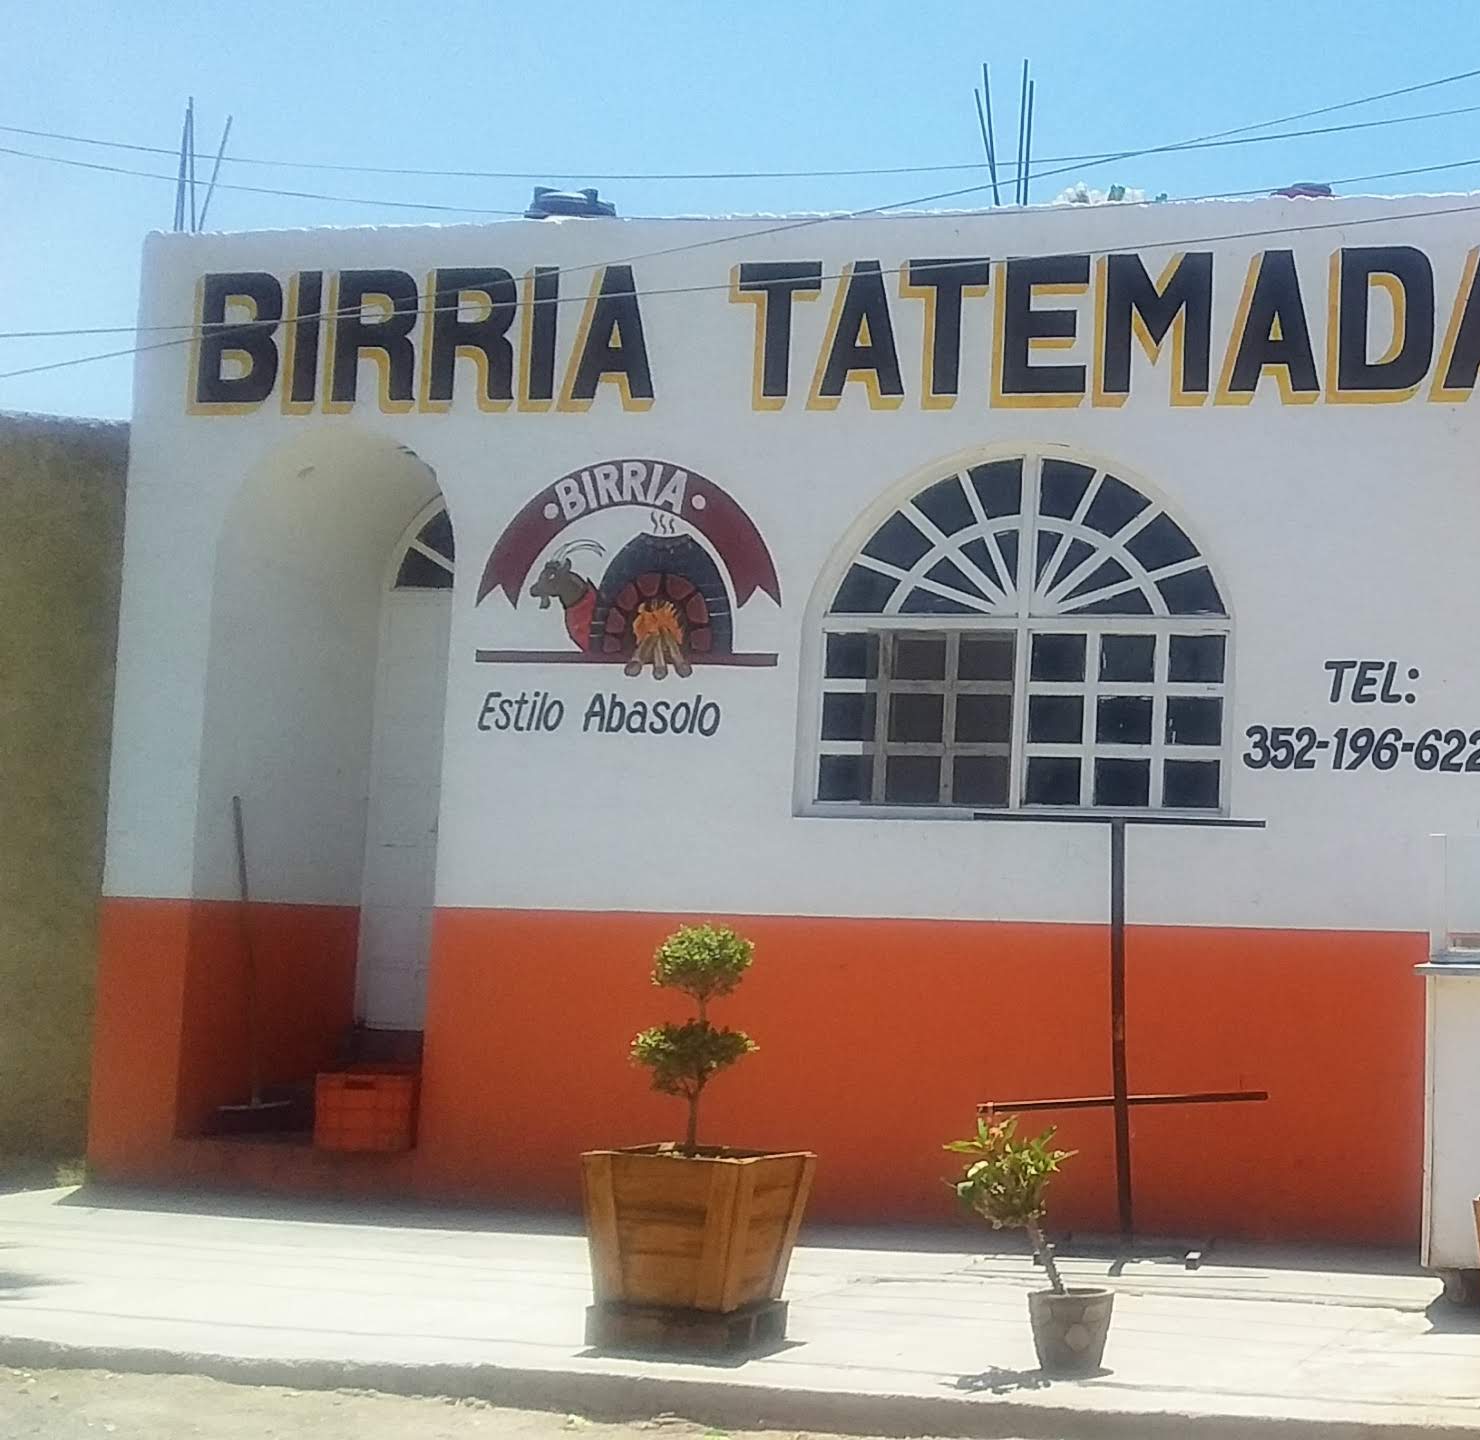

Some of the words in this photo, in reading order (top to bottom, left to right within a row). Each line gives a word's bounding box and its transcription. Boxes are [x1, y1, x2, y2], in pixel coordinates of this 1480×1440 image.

[186, 264, 656, 416] BIRRIA
[555, 461, 688, 521] BIRRIA
[1324, 659, 1420, 704] TEL:
[477, 691, 565, 732] Estilo
[582, 692, 722, 738] Abasolo
